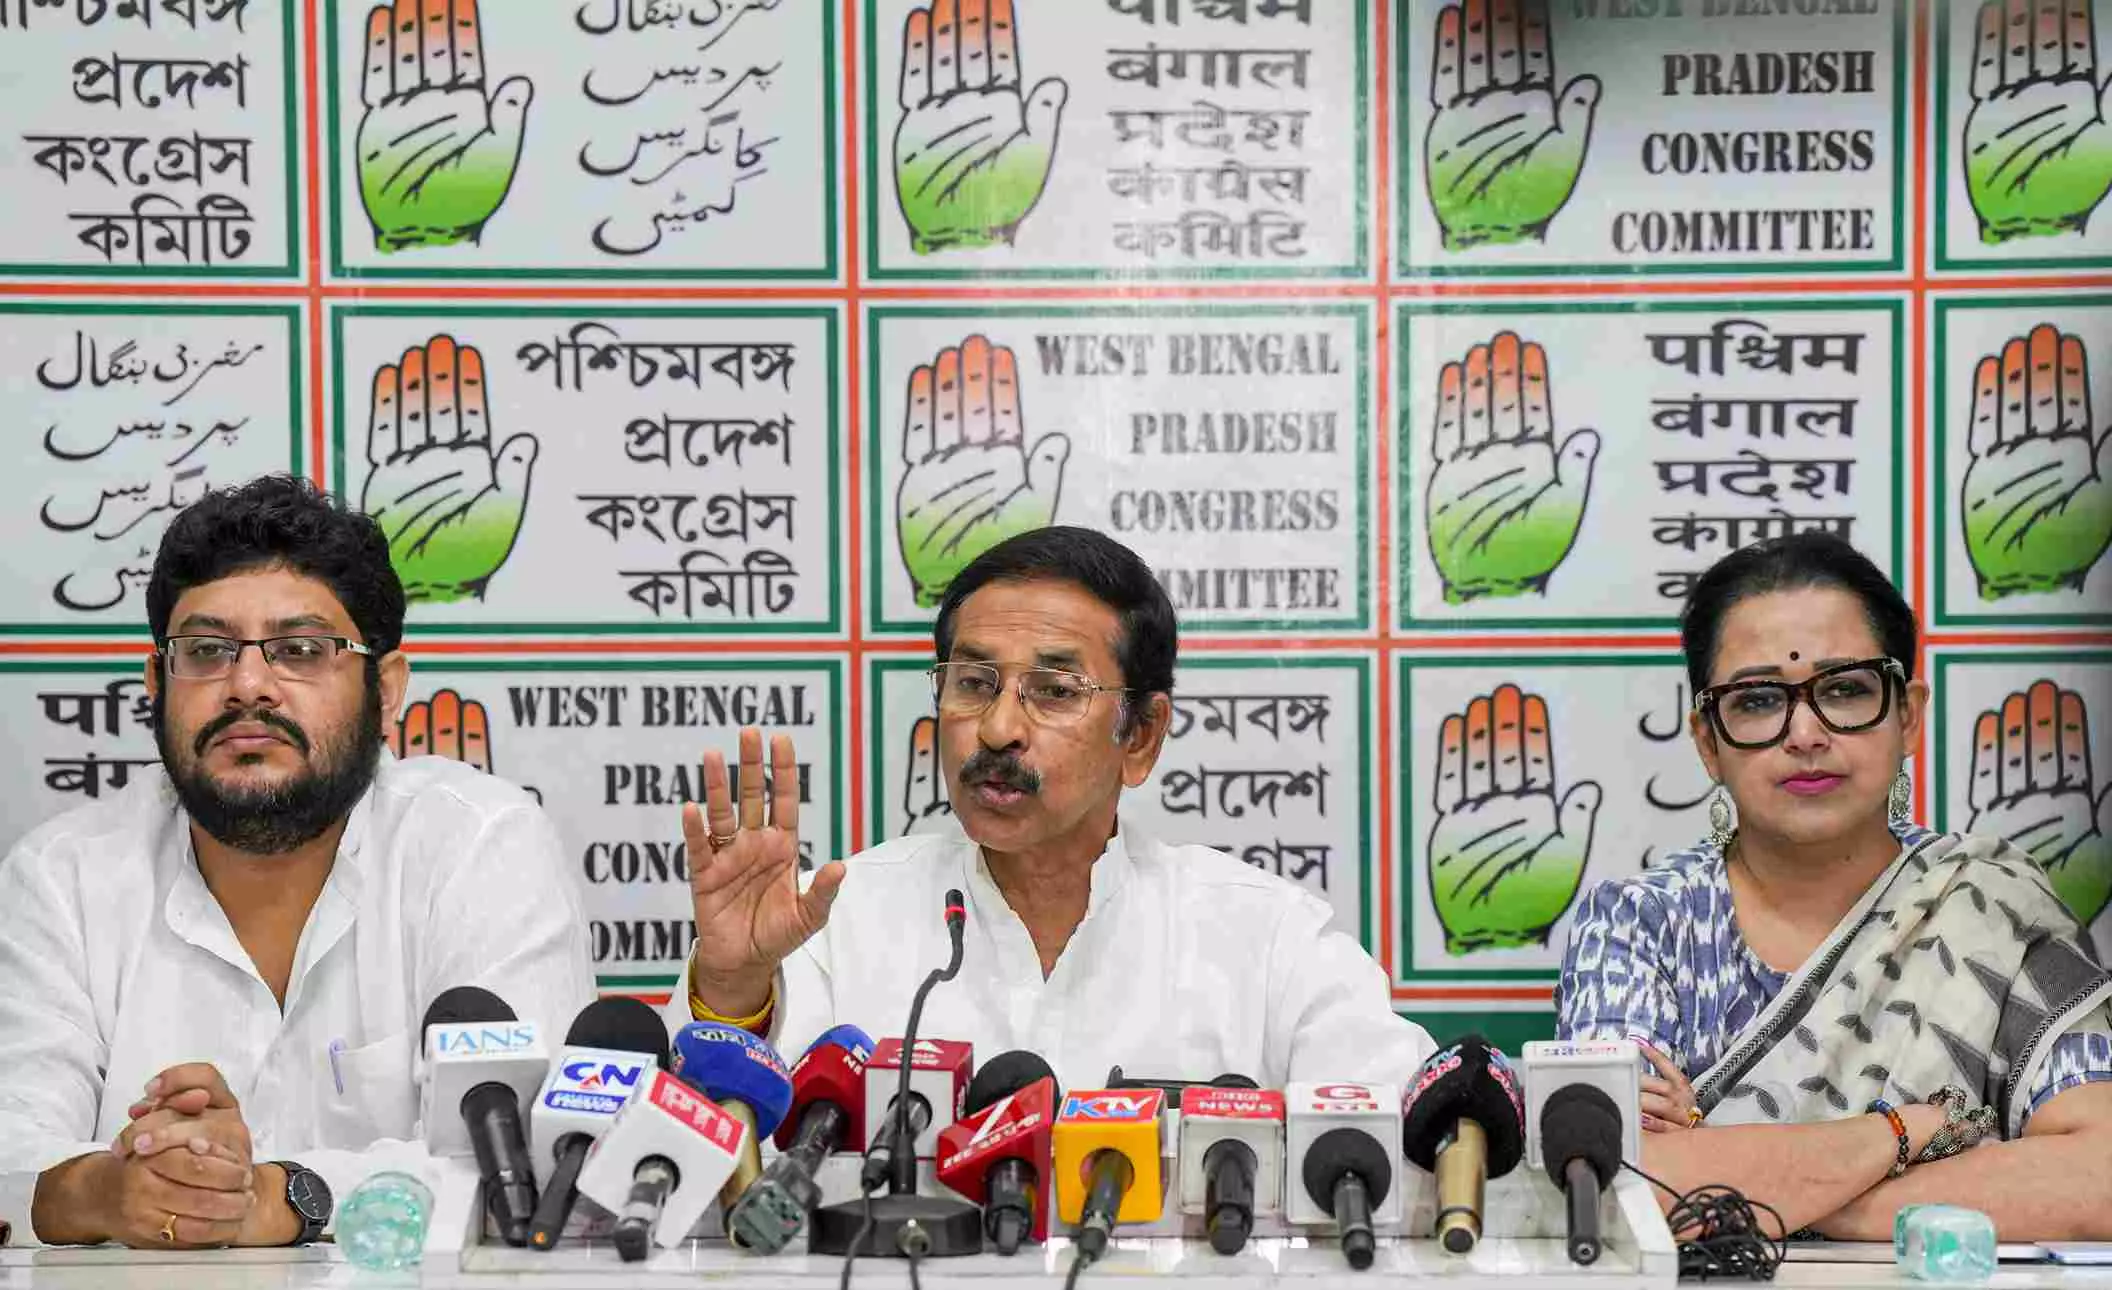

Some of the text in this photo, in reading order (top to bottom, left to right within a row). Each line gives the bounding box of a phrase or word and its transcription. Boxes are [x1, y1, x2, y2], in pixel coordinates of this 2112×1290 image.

[73, 52, 249, 108] প্রদেশ
[1107, 43, 1311, 88] बंगाल
[1663, 51, 1874, 95] PRADESH
[23, 132, 251, 186] কংগ্রেস
[1642, 130, 1873, 174] CONGRESS
[68, 193, 253, 266] কমিটি
[1613, 209, 1873, 252] COMMITTEE
[516, 322, 794, 391] পশ্চিমবঙ্গ
[1035, 334, 1339, 376] WEST BENGAL
[1645, 320, 1866, 376] पश्चिम
[1131, 412, 1336, 454] PRADESH
[1652, 393, 1858, 438] बंगाल
[625, 414, 794, 467] প্রদেশ
[1653, 450, 1856, 502] प्रदेश
[577, 490, 796, 542] কংগ্রেস
[1111, 490, 1338, 531] CONGRESS
[619, 550, 798, 618] কমিটি
[508, 686, 814, 727] WEST BENGAL
[1161, 765, 1330, 817] প্রদেশ
[439, 1026, 534, 1052] IANS
[1198, 1100, 1273, 1113] NEWS
